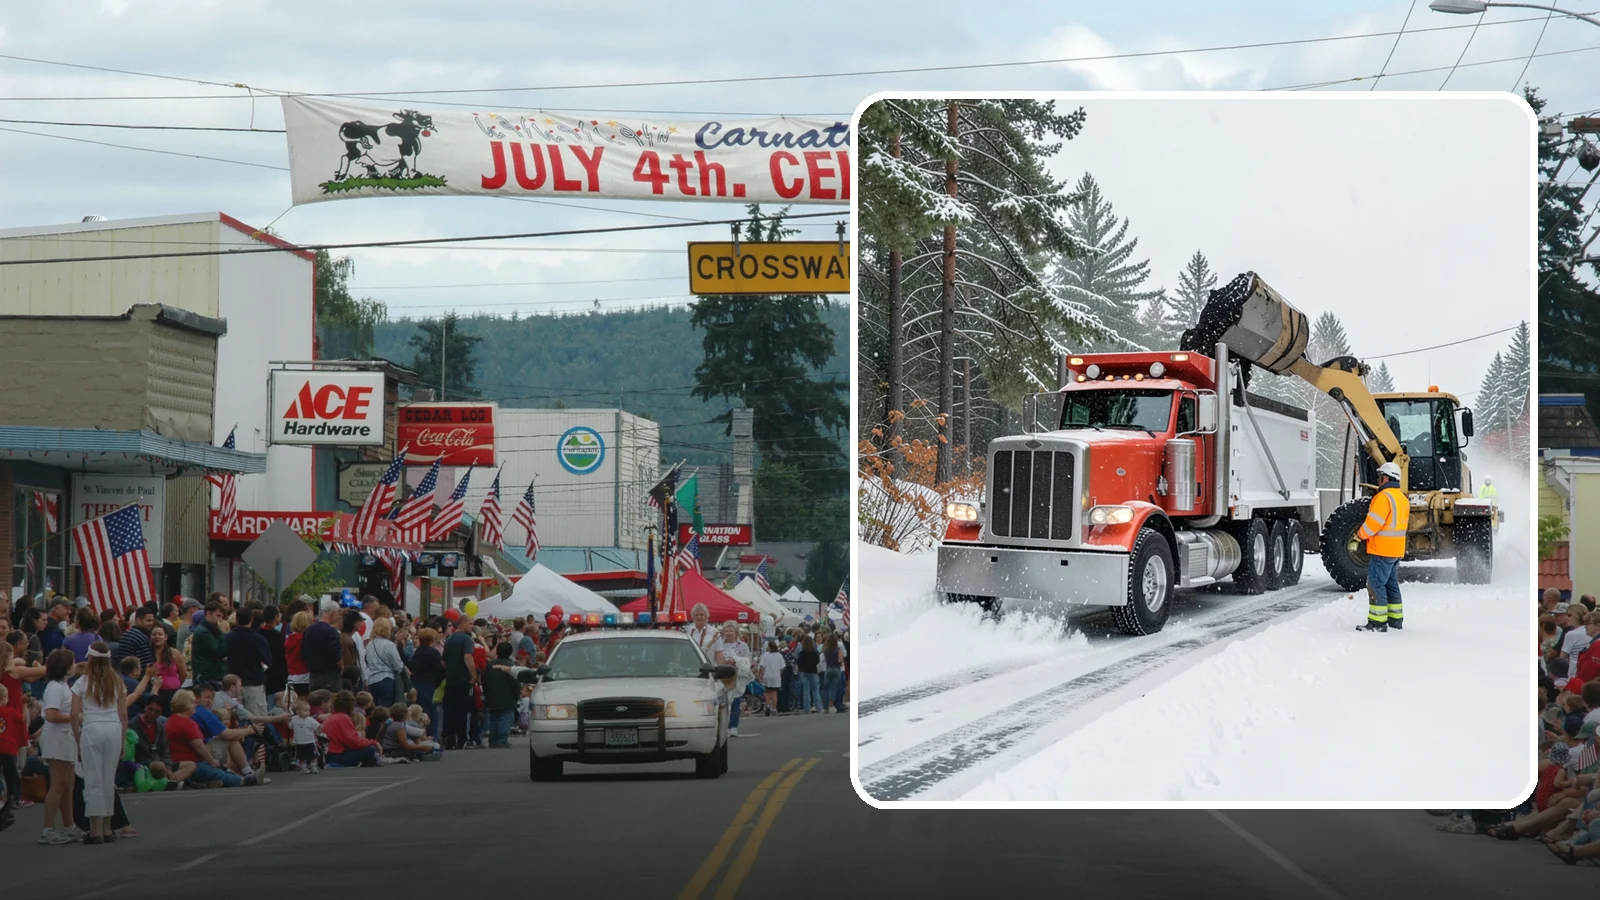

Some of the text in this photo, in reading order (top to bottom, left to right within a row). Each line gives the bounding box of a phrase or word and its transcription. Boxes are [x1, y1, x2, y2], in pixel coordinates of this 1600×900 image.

[695, 121, 850, 149] Carnat
[481, 141, 605, 192] JULY
[632, 150, 747, 198] 4th.
[697, 254, 850, 280] CROSSWA
[283, 380, 373, 420] ACE
[405, 409, 485, 421] CEDAR LOG
[283, 421, 371, 436] Hardware
[416, 428, 477, 447] Coca-Cola
[83, 485, 155, 495] St. Vincent de Paul
[688, 527, 742, 535] CRNATION
